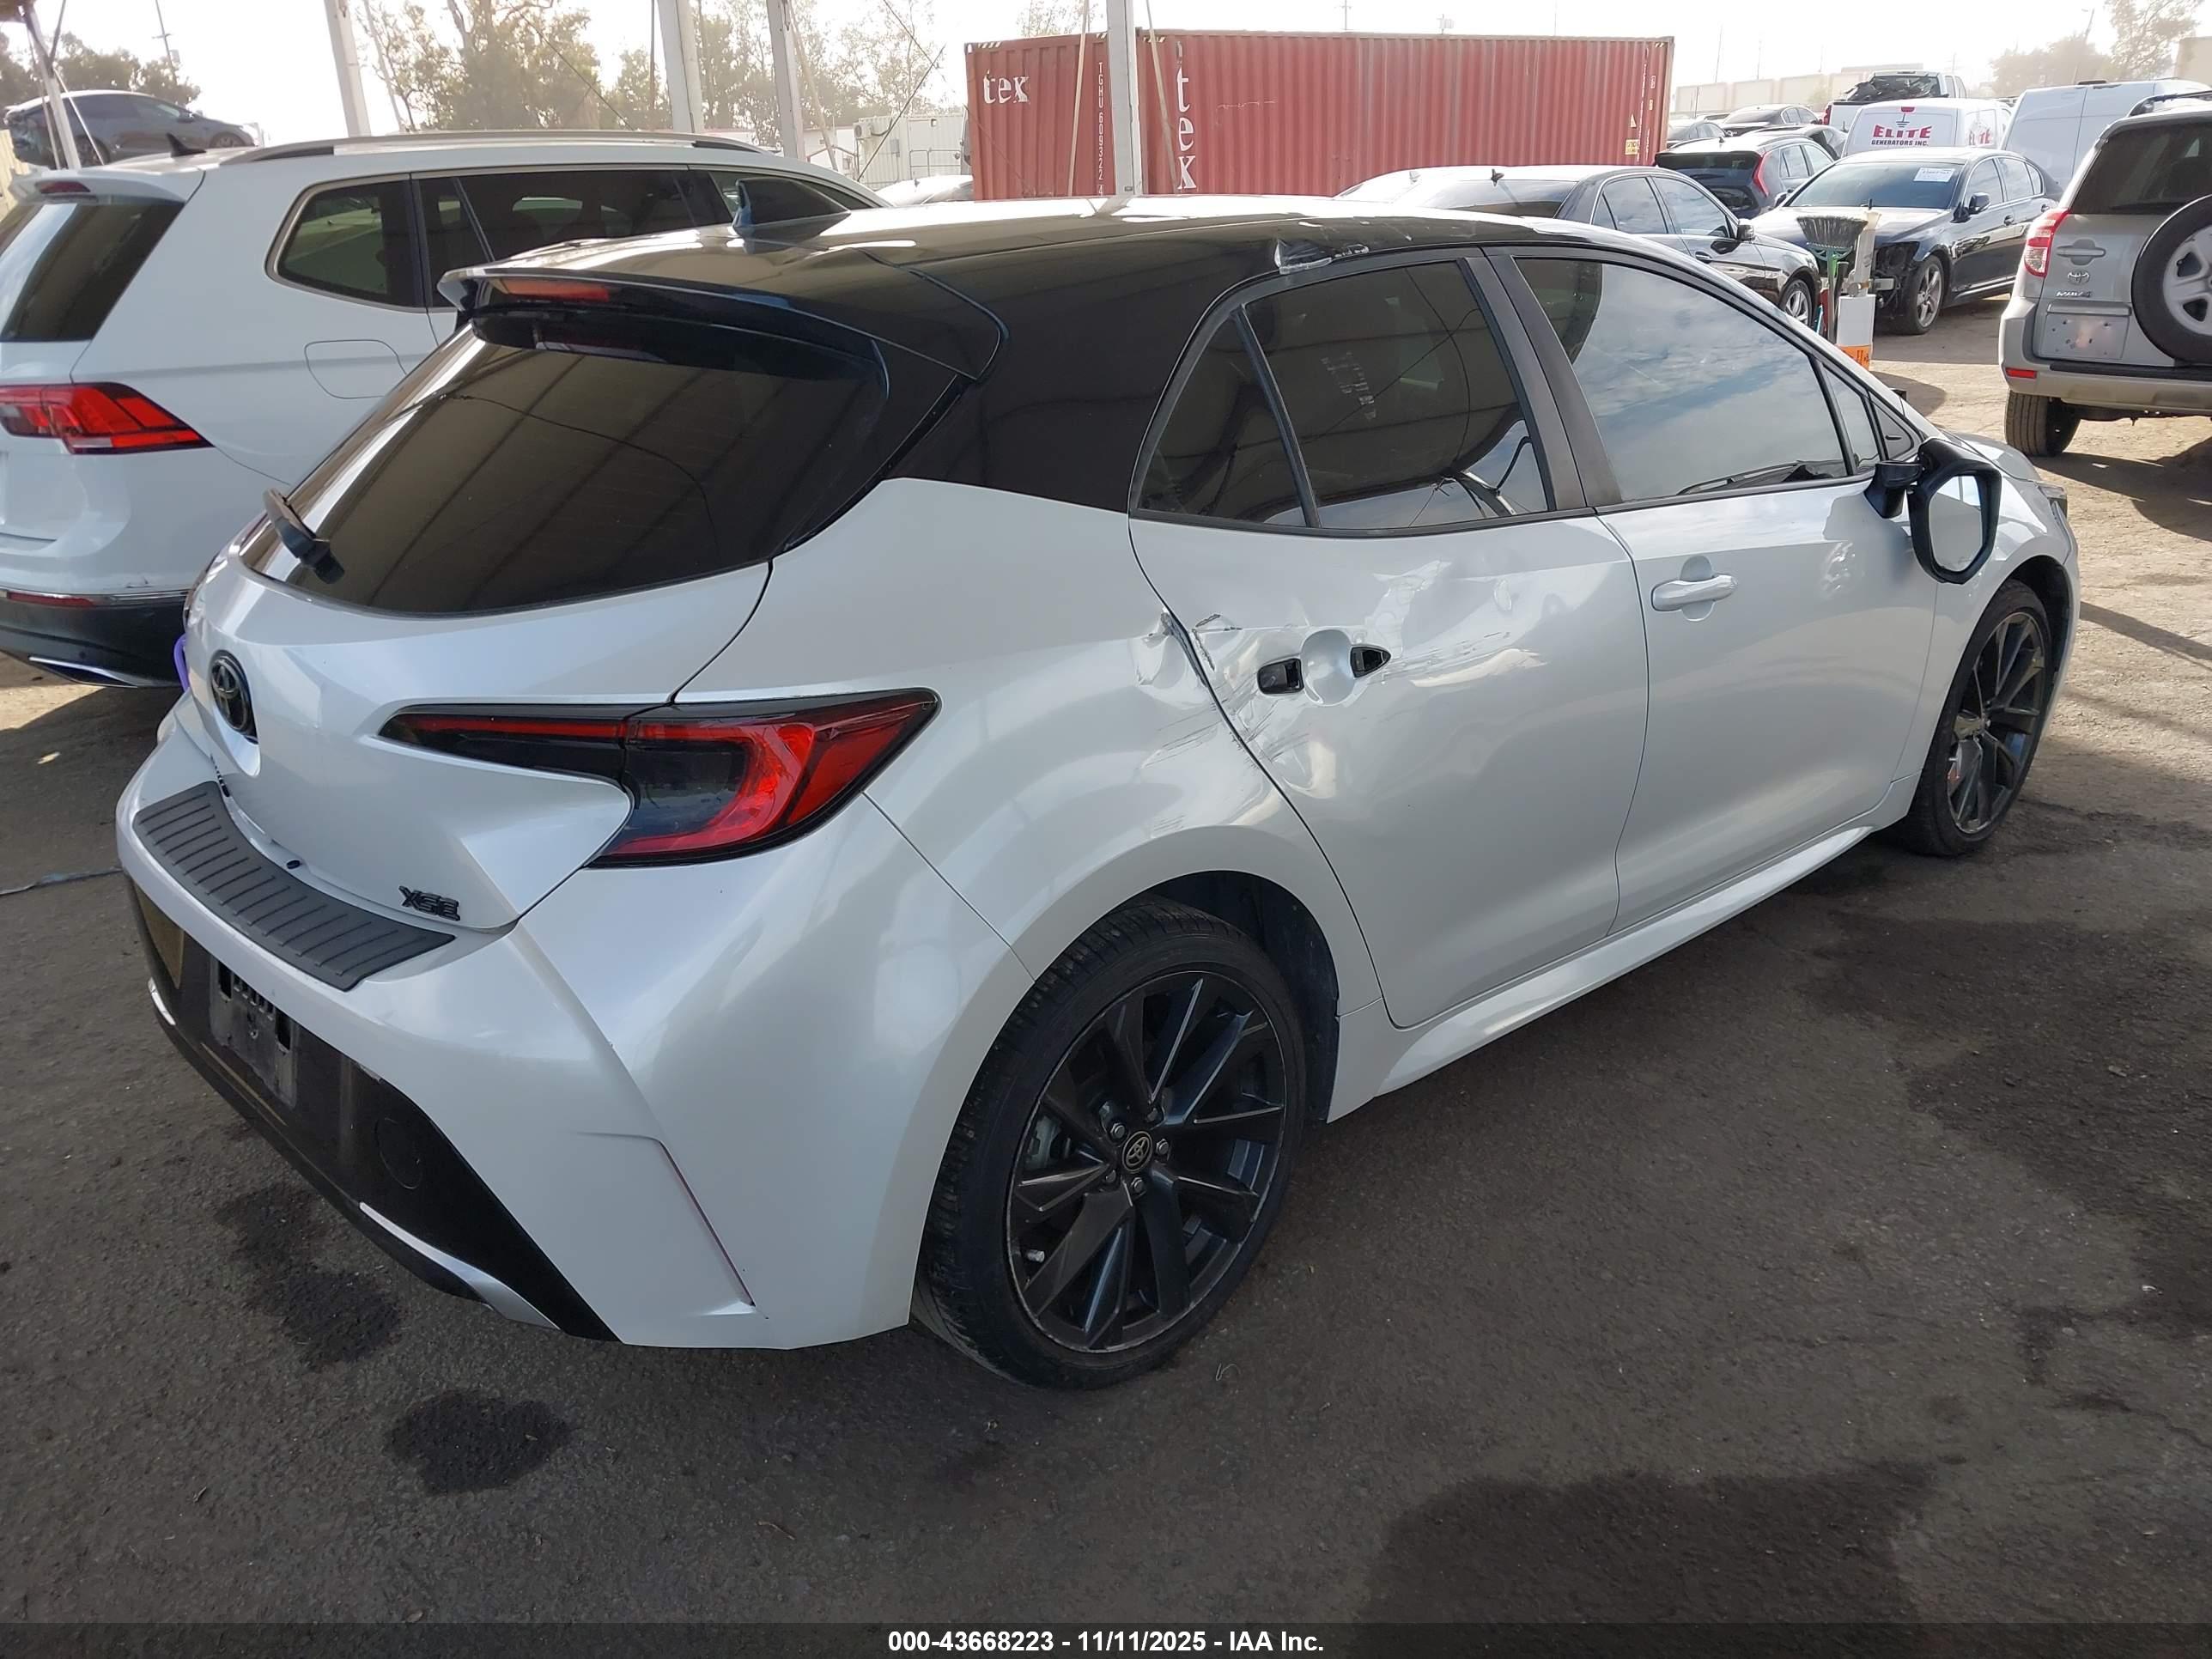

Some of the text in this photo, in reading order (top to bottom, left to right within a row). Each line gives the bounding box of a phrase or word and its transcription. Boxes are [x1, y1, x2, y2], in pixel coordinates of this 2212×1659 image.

[983, 70, 1030, 104] tex
[1177, 66, 1197, 190] tex
[1873, 125, 1932, 139] ELITE
[1968, 128, 1992, 146] ELTE
[398, 885, 461, 921] XSE
